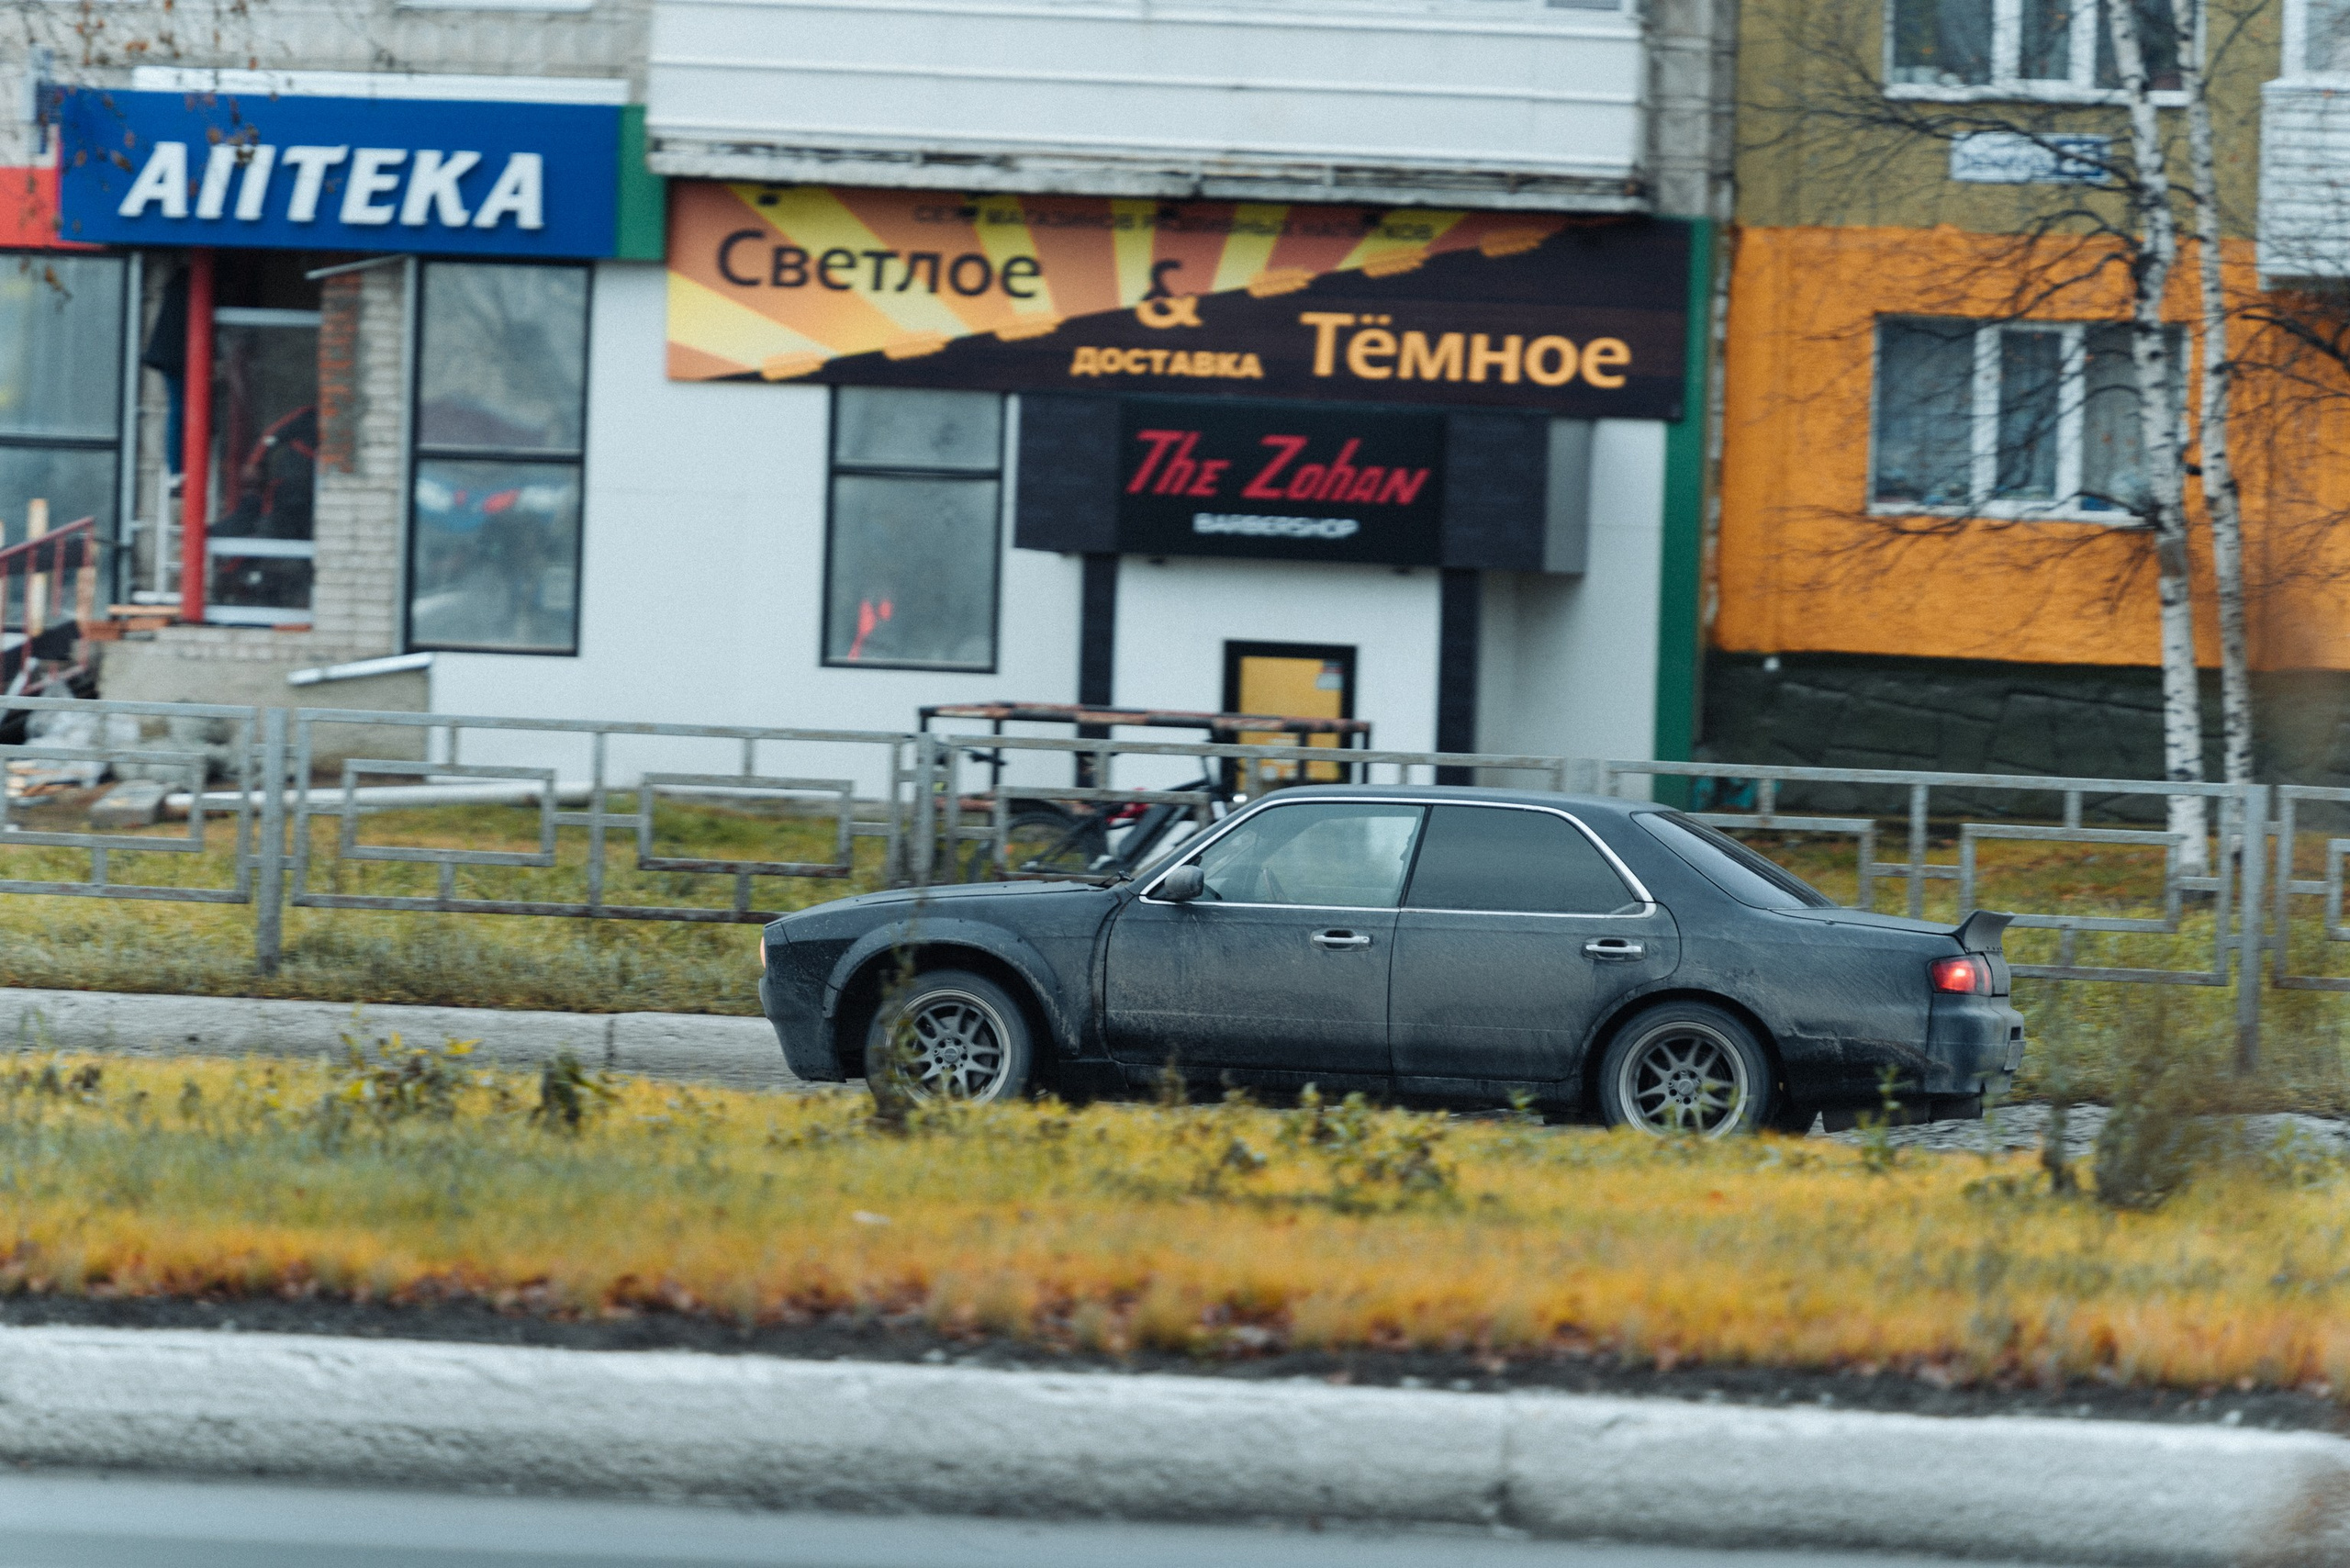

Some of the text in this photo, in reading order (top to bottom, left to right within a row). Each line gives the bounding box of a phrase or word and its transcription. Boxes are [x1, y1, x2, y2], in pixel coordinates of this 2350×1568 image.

[119, 141, 543, 230] АПТЕКА
[717, 228, 1633, 389] Светлое & Тёмное
[1069, 345, 1265, 379] ДОСТАВКА
